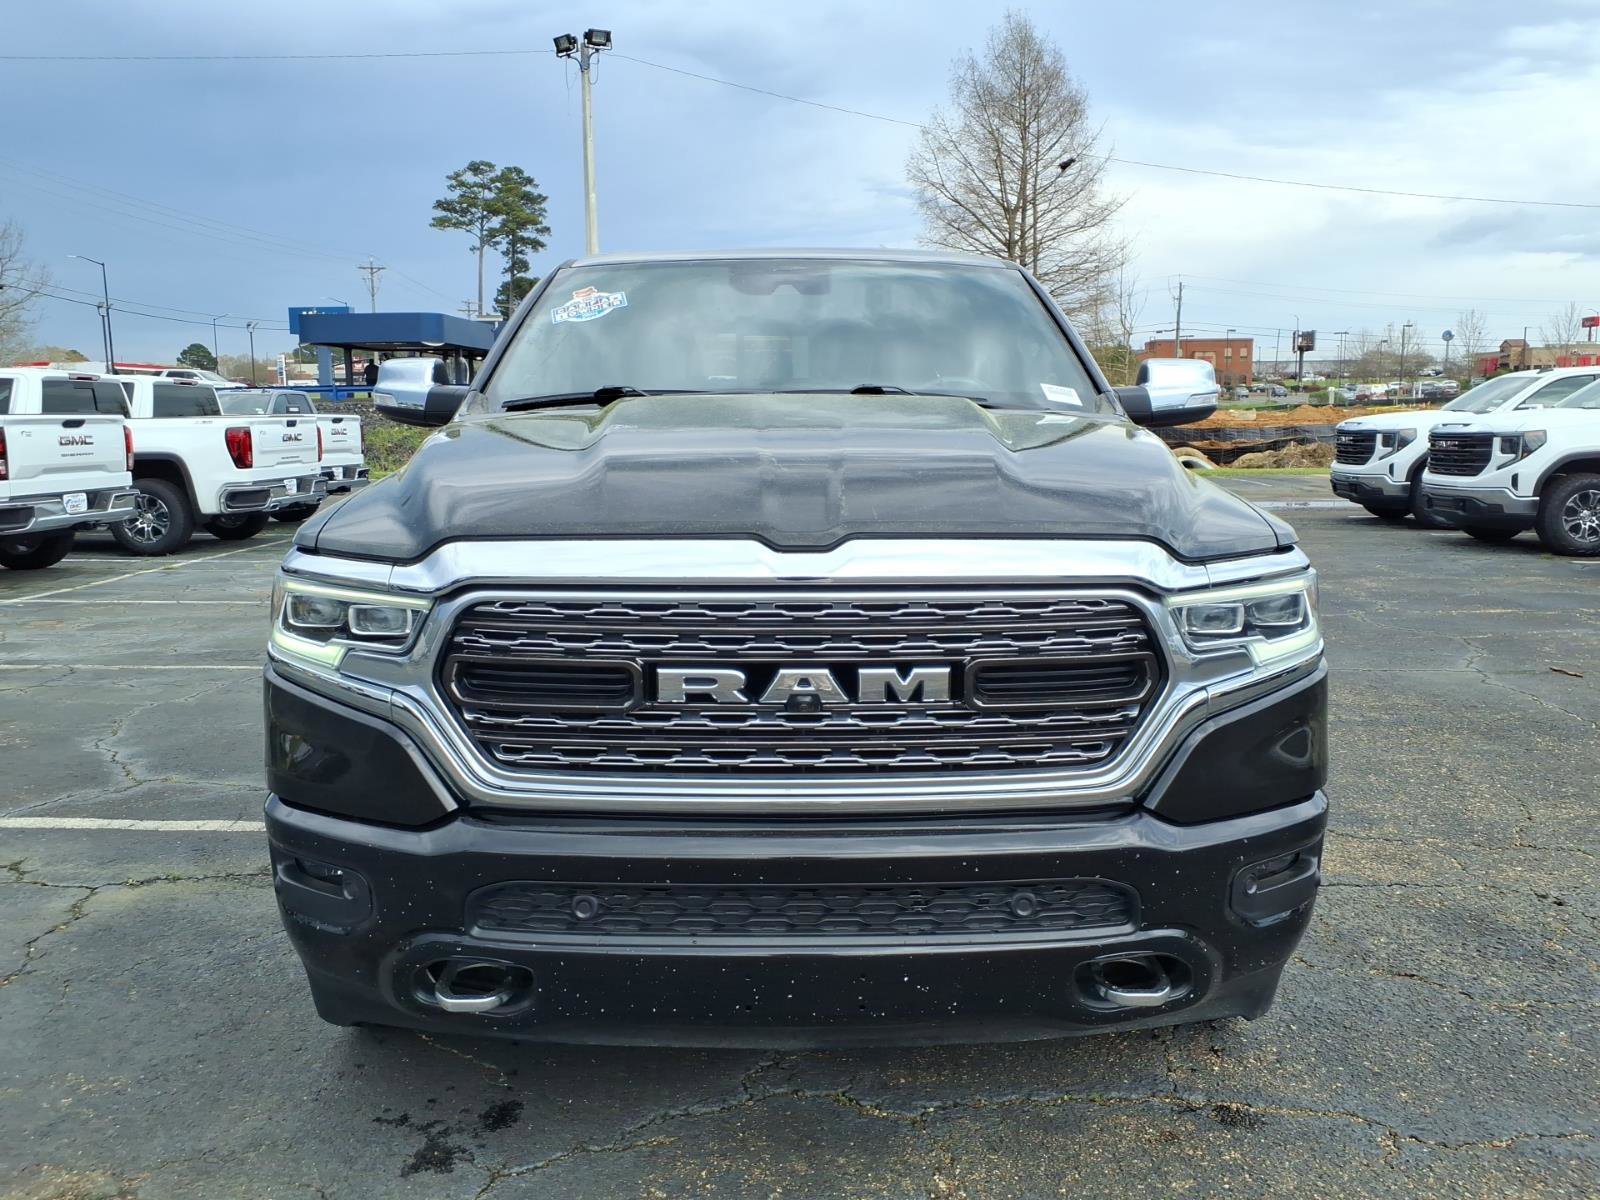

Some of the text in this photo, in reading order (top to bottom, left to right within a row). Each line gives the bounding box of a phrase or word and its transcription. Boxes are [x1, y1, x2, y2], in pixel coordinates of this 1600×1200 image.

[59, 436, 94, 446] GMC
[282, 433, 302, 442] GMC
[656, 667, 951, 703] RAM
